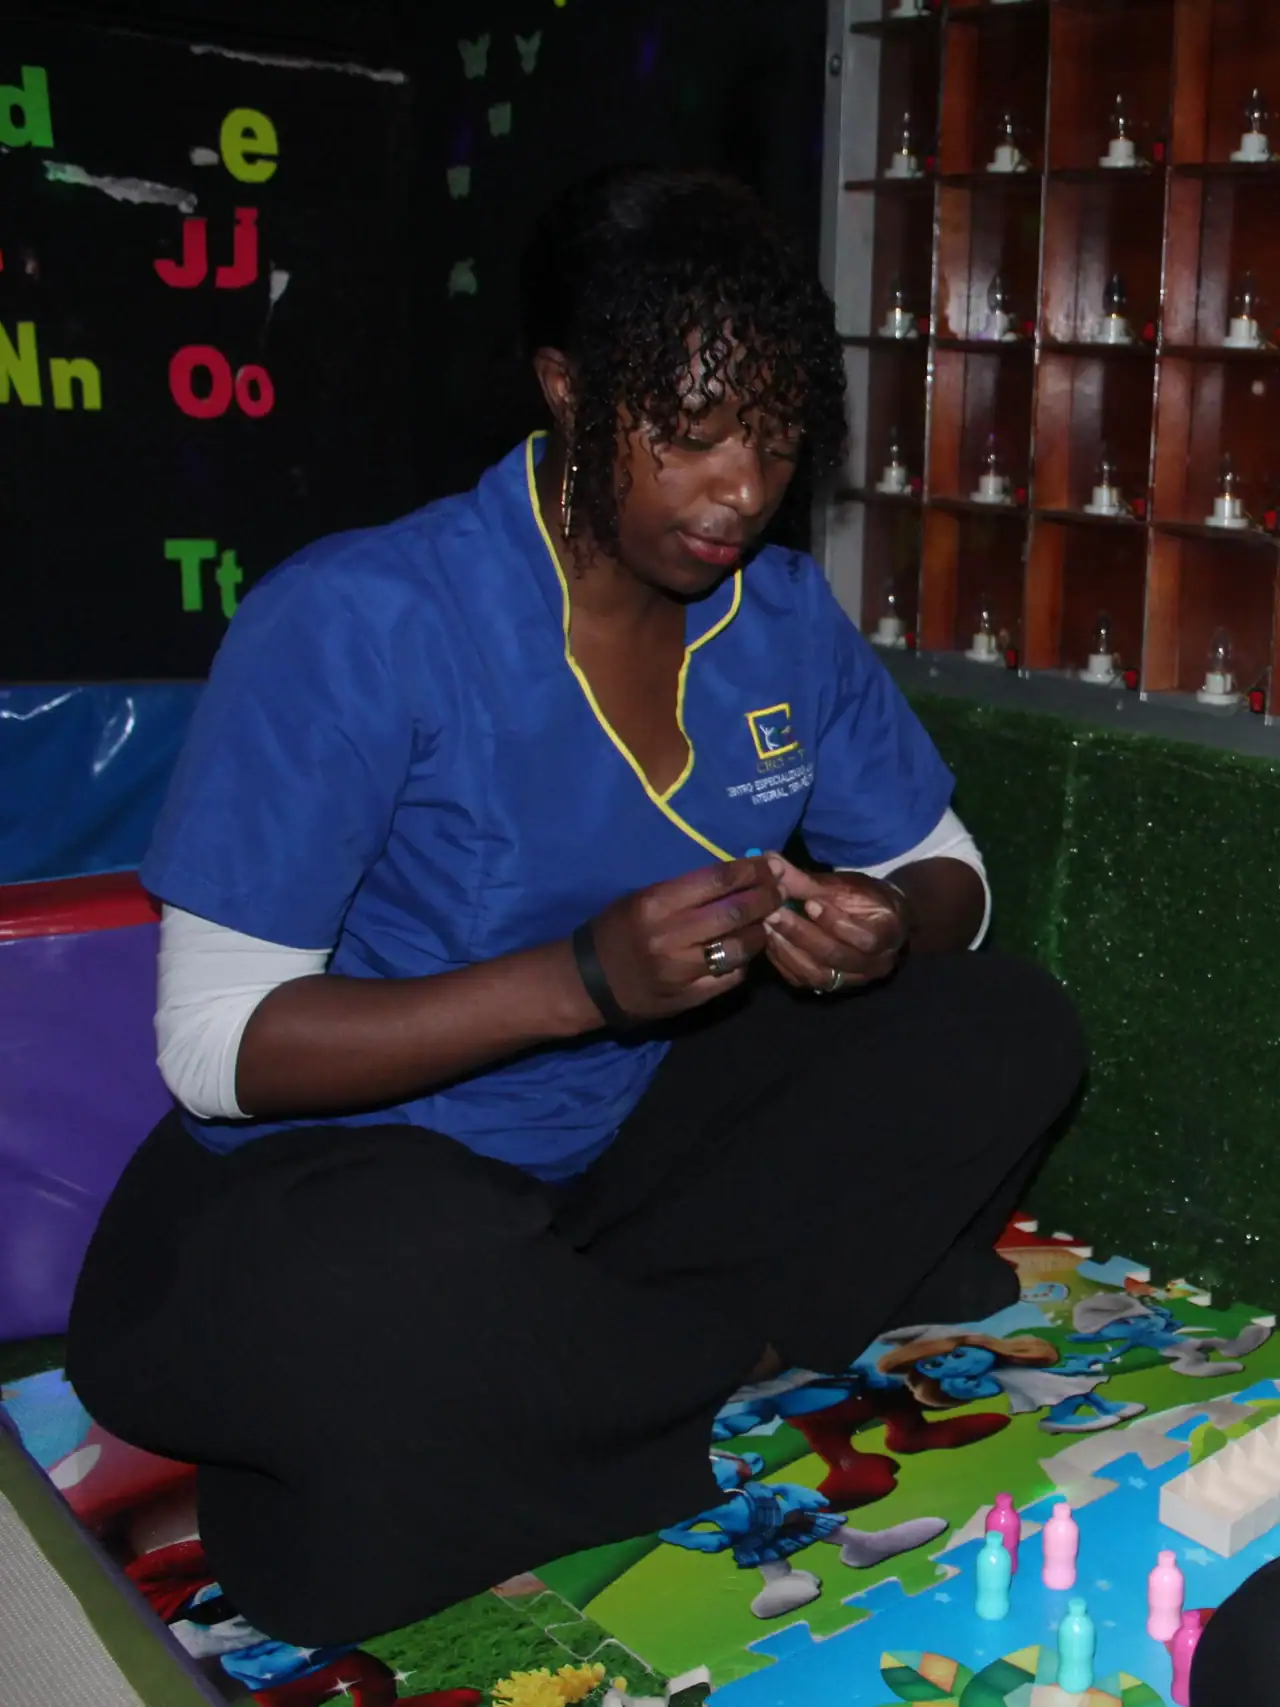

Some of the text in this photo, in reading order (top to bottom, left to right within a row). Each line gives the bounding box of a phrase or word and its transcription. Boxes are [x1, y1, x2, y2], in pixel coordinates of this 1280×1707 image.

[220, 107, 278, 183] e
[0, 322, 102, 409] Nn
[169, 345, 274, 419] Oo
[164, 539, 243, 619] Tt
